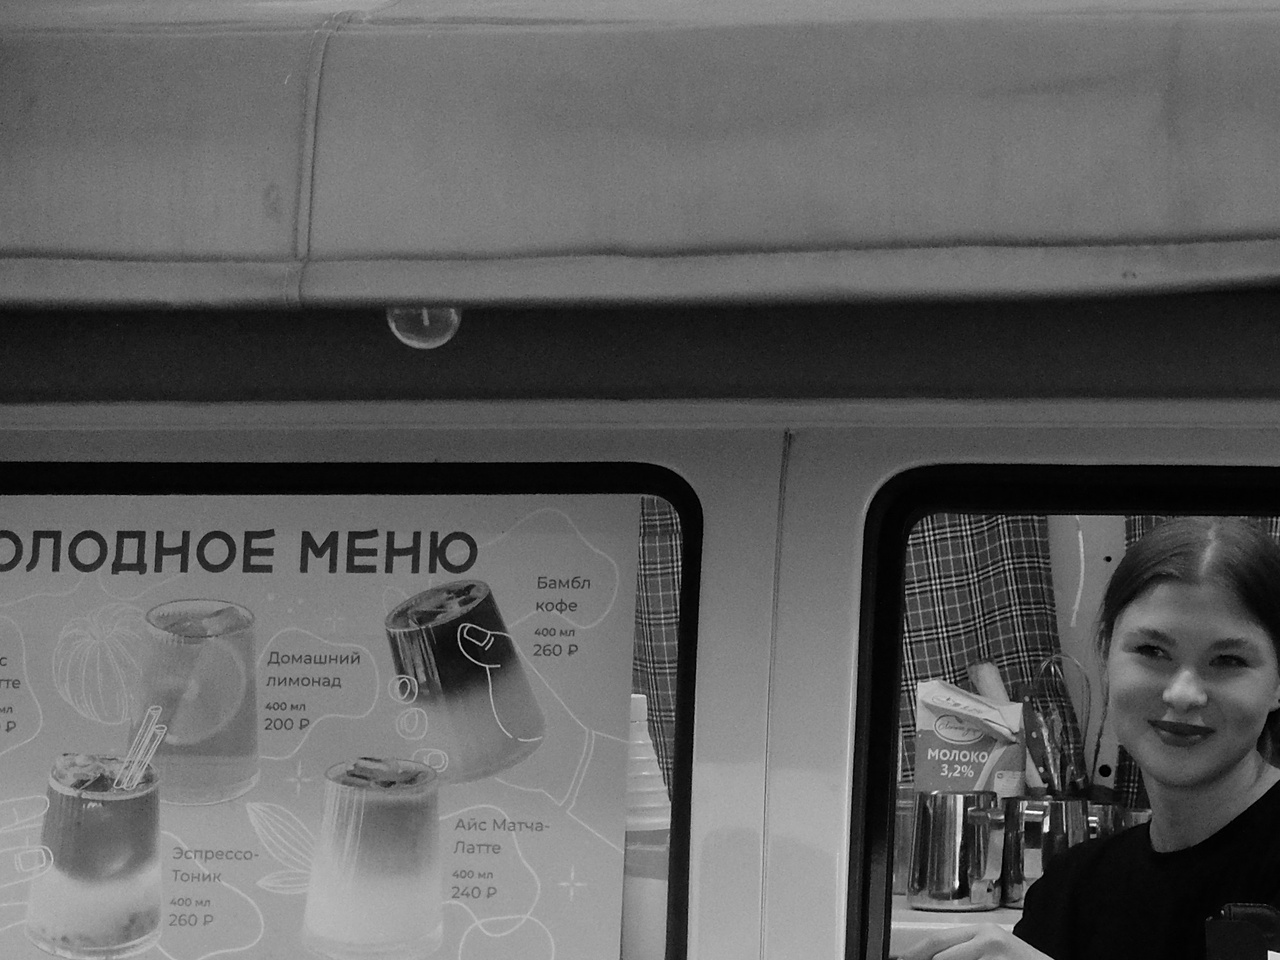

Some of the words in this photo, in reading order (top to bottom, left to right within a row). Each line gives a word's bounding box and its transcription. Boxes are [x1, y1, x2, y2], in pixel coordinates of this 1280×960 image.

[300, 528, 479, 574] МЕНЮ
[537, 576, 591, 590] Бамбл
[536, 598, 578, 615] кофе
[534, 627, 557, 637] 400
[559, 629, 576, 637] мл
[533, 643, 563, 657] 260
[267, 651, 361, 667] Домашний
[266, 676, 342, 689] лимонад
[265, 702, 288, 712] 400
[290, 703, 307, 712] мл
[264, 718, 294, 731] 200
[927, 748, 989, 764] МОЛОКО
[940, 764, 975, 779] 3,2%
[454, 817, 487, 832] Айс
[453, 841, 502, 855] Латте
[172, 869, 222, 883] Тоник
[452, 870, 475, 880] 400
[477, 872, 494, 880] мл
[451, 886, 482, 900] 240
[169, 898, 192, 908] 400
[195, 900, 211, 908] мл
[168, 913, 198, 928] 260
